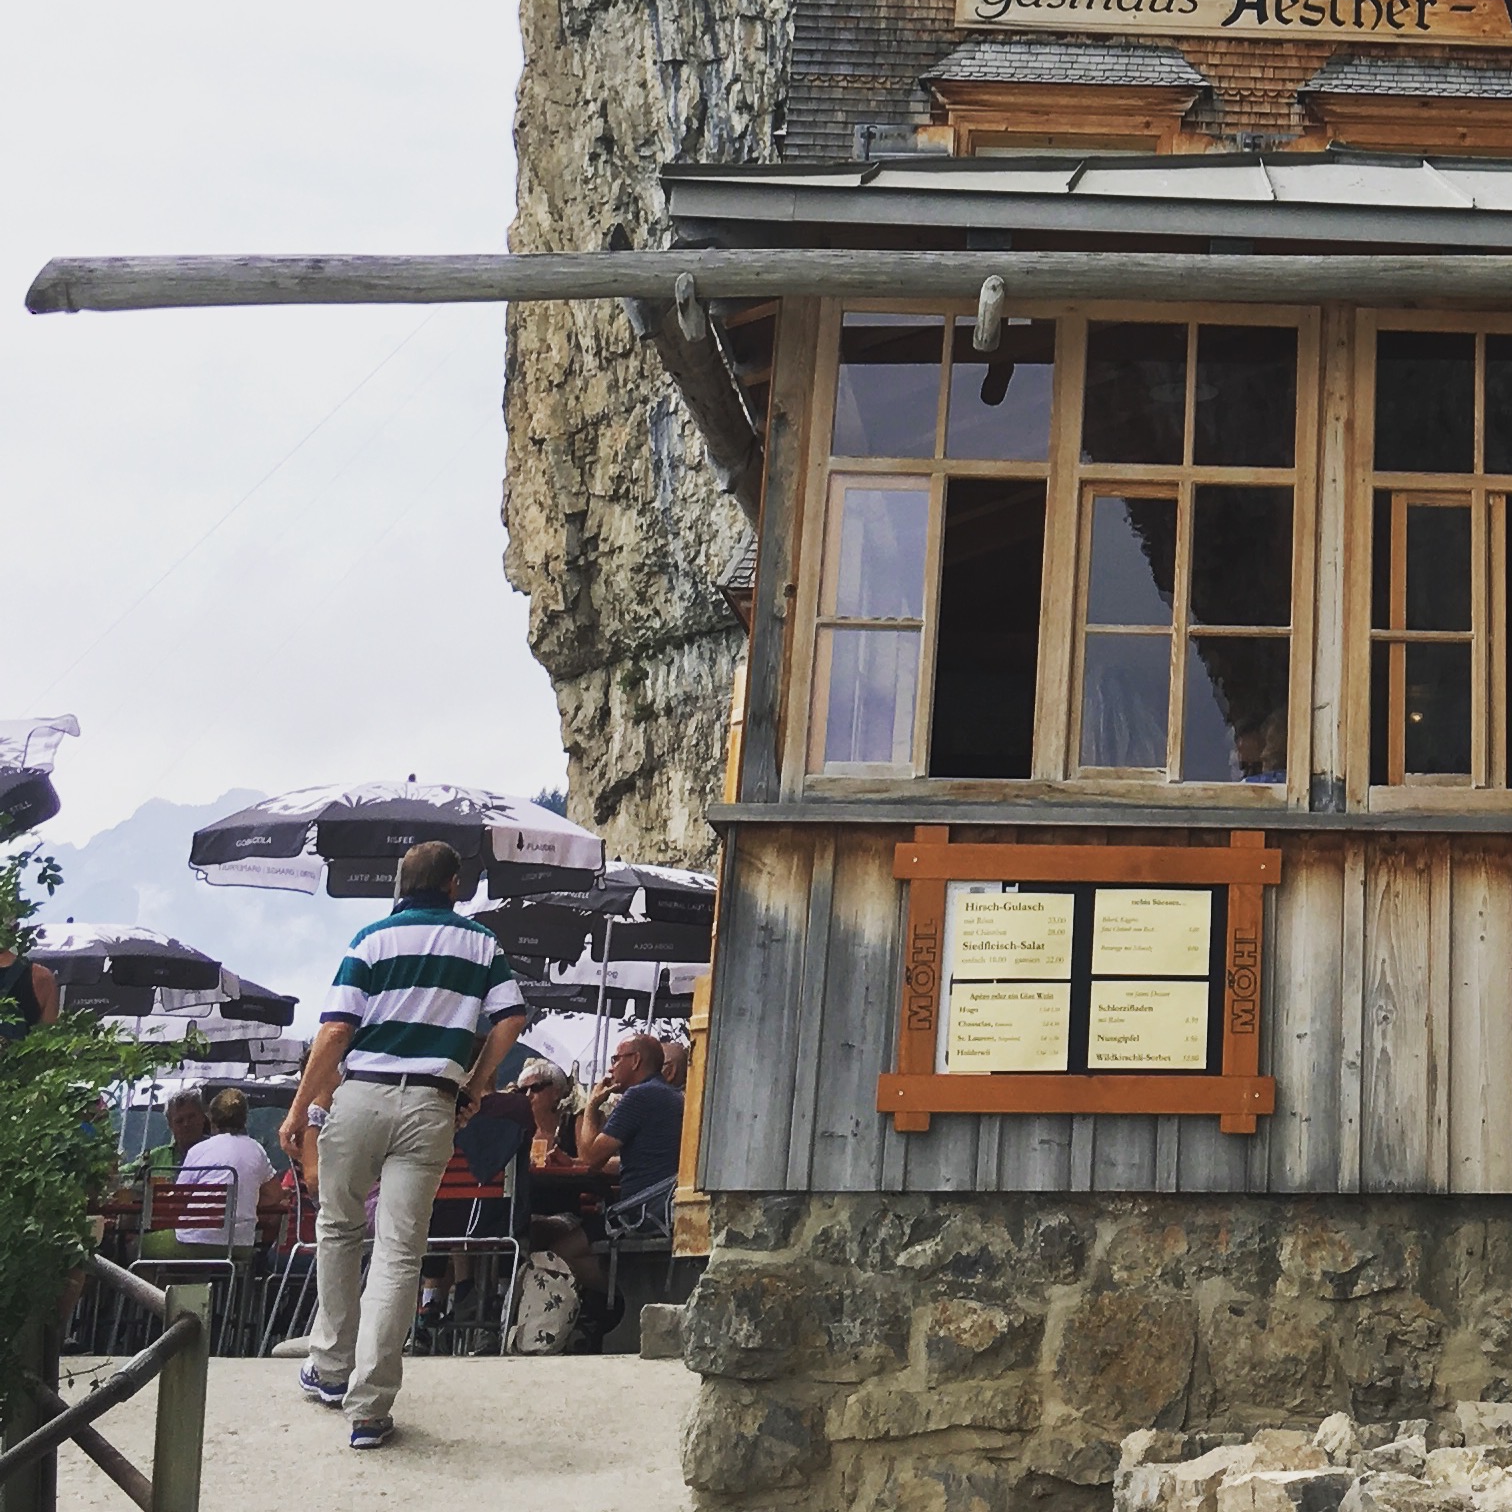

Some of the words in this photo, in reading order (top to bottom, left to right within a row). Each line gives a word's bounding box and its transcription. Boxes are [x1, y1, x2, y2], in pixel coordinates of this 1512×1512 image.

[965, 902, 1045, 912] Hirsch-Gulasch
[905, 918, 937, 1030] MÖHL
[962, 941, 1046, 951] Siedfleisch-Salat
[1227, 921, 1258, 1034] MÖHL
